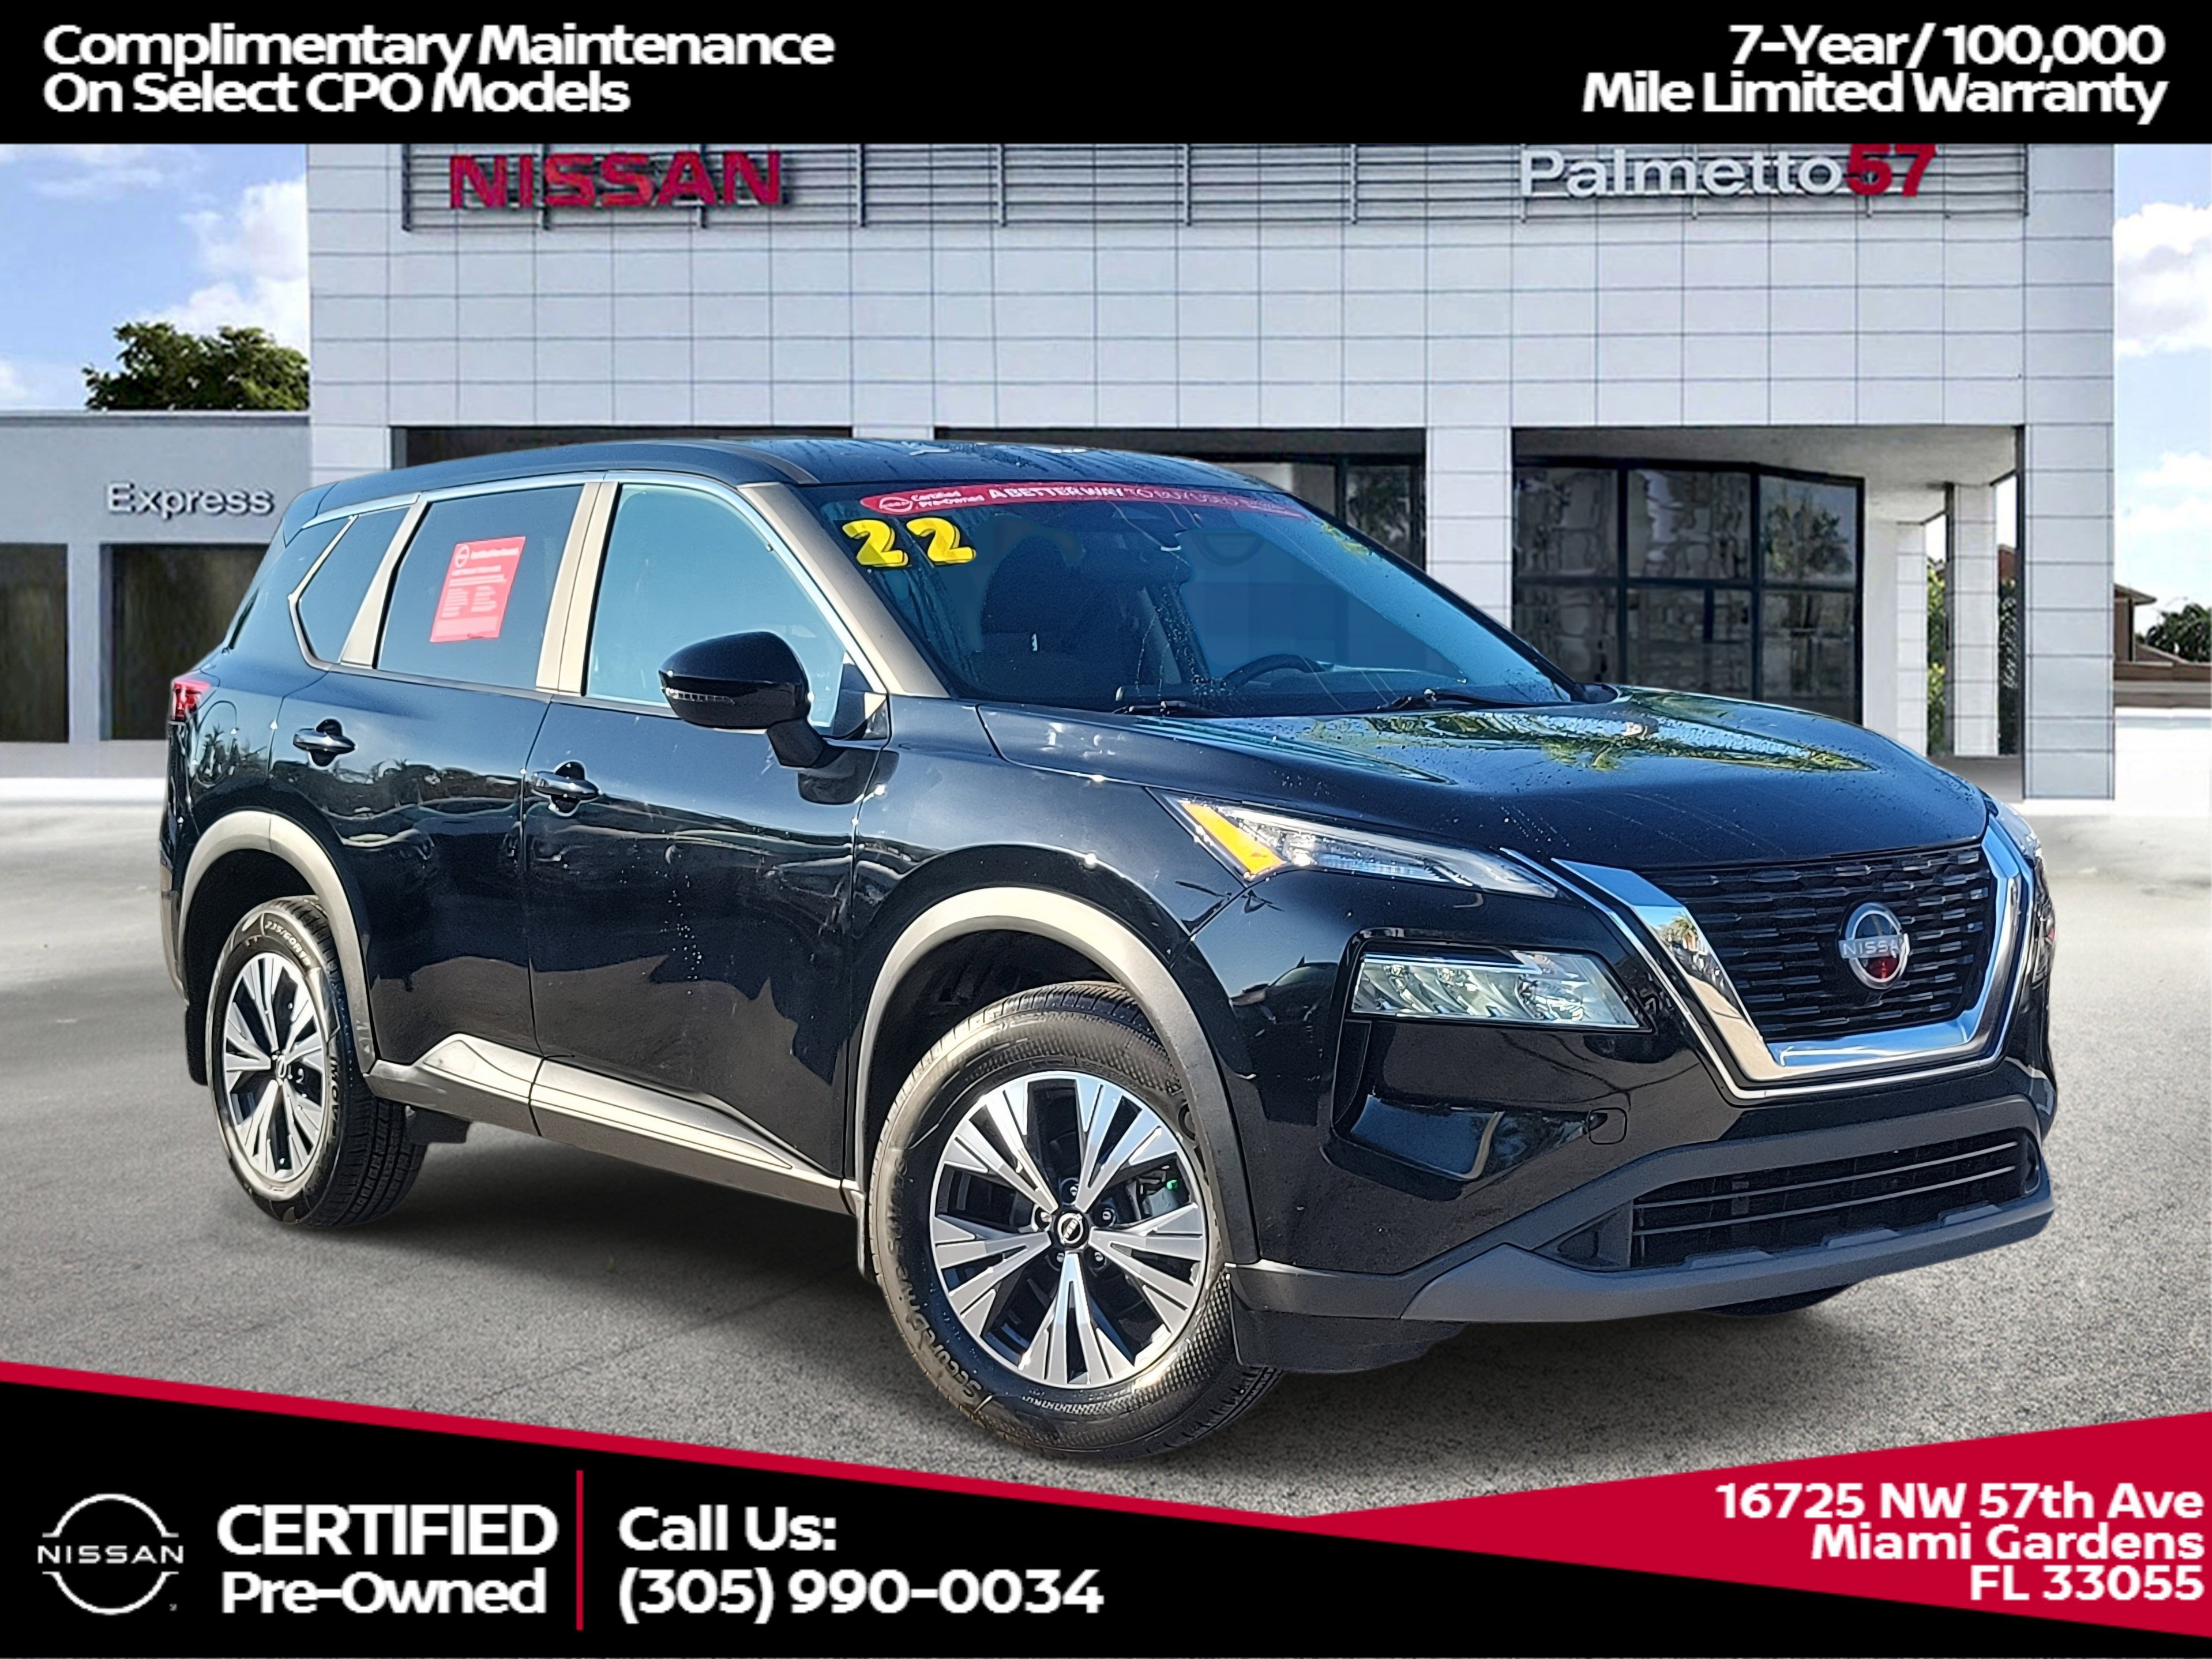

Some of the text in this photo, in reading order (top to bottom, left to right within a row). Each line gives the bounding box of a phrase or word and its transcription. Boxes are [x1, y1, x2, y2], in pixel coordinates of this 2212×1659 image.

[449, 151, 781, 209] NISSAN
[107, 482, 275, 519] Express
[842, 517, 977, 568] 22
